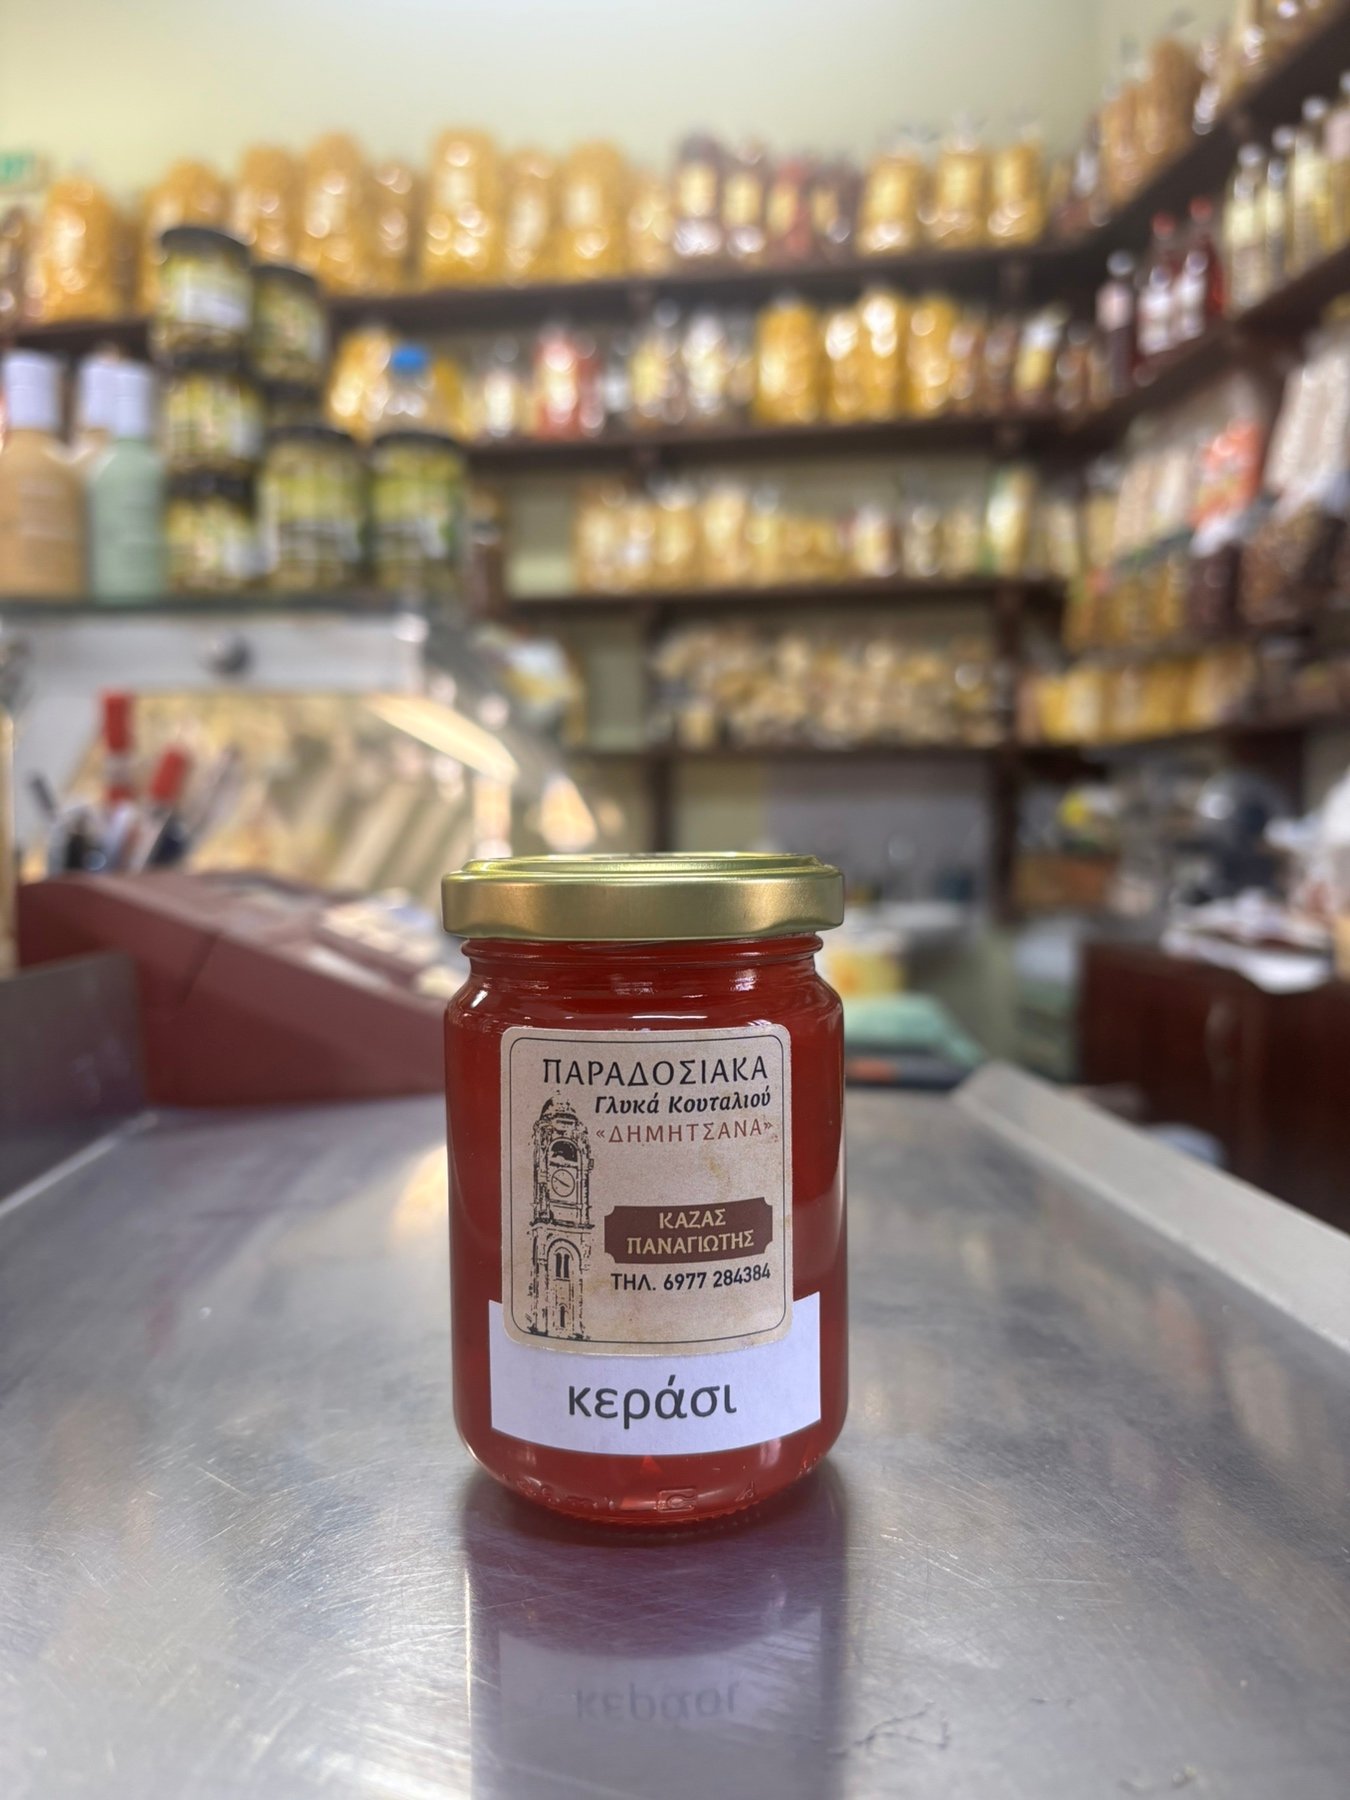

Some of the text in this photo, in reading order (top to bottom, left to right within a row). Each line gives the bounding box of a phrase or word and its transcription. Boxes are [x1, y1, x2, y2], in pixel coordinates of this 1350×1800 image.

[542, 1055, 769, 1087] ΠΑΡΑΔΟΣΙΑΚΑ
[594, 1086, 772, 1115] Γλυκά Κουταλιού
[595, 1118, 774, 1143] «ΔΗΜΗΤΣΑΝΑ»
[658, 1208, 727, 1230] ΚΑΖΑΣ
[626, 1229, 755, 1255] ΠΑΝΑΓΙΩΤΗΣ
[610, 1262, 771, 1291] ΤΗΛ. 6977 284384
[568, 1374, 737, 1430] κεράσι
